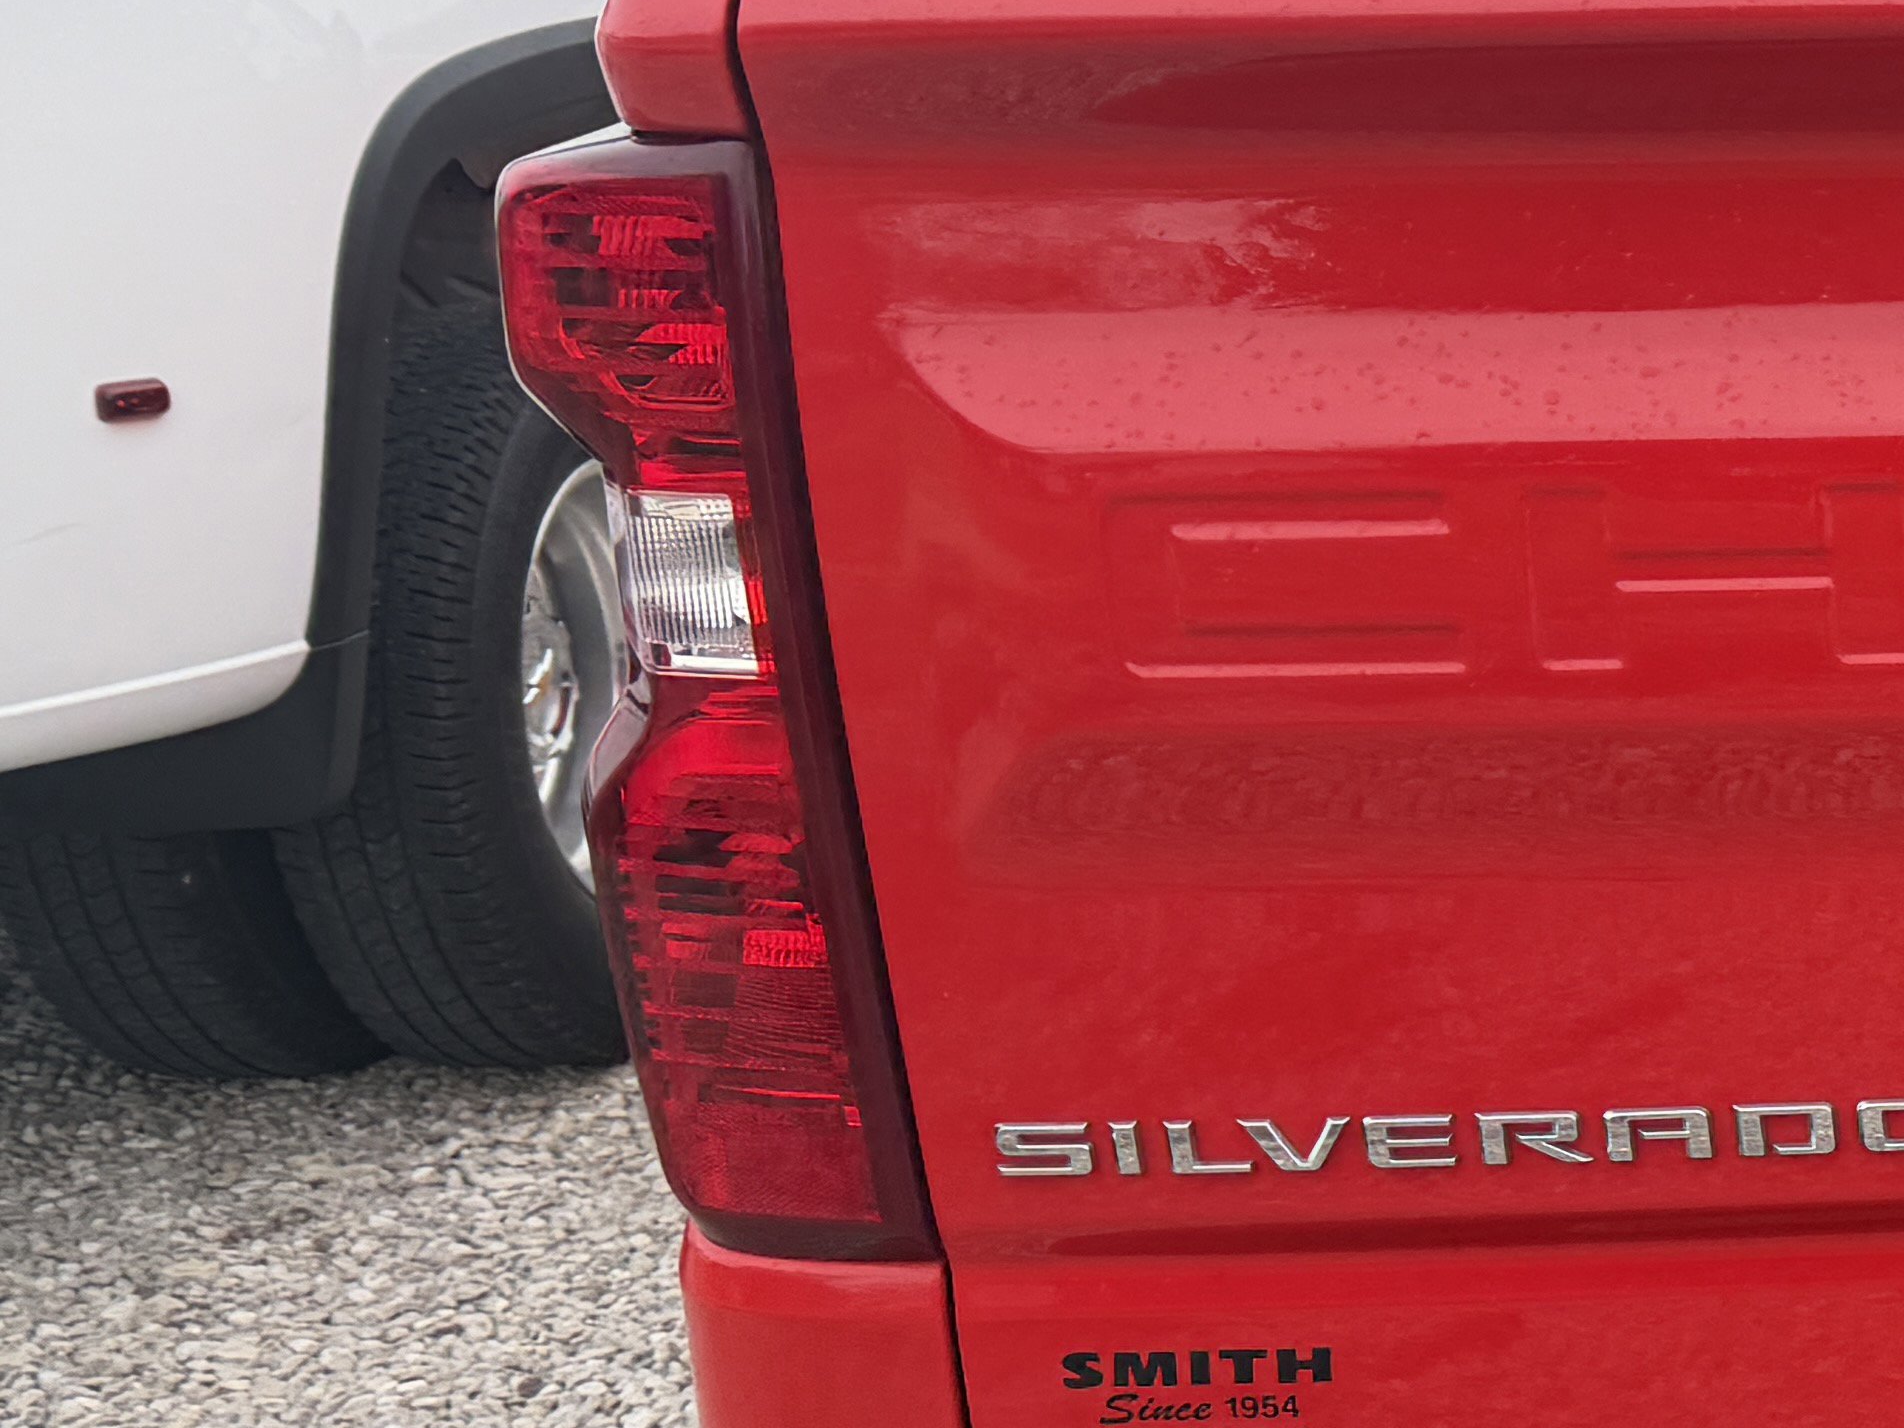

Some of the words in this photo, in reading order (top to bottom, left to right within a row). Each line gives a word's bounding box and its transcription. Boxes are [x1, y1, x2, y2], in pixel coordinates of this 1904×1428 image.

[1061, 1347, 1332, 1389] SMITH
[1098, 1393, 1212, 1425] Since
[1224, 1394, 1300, 1419] 1954
